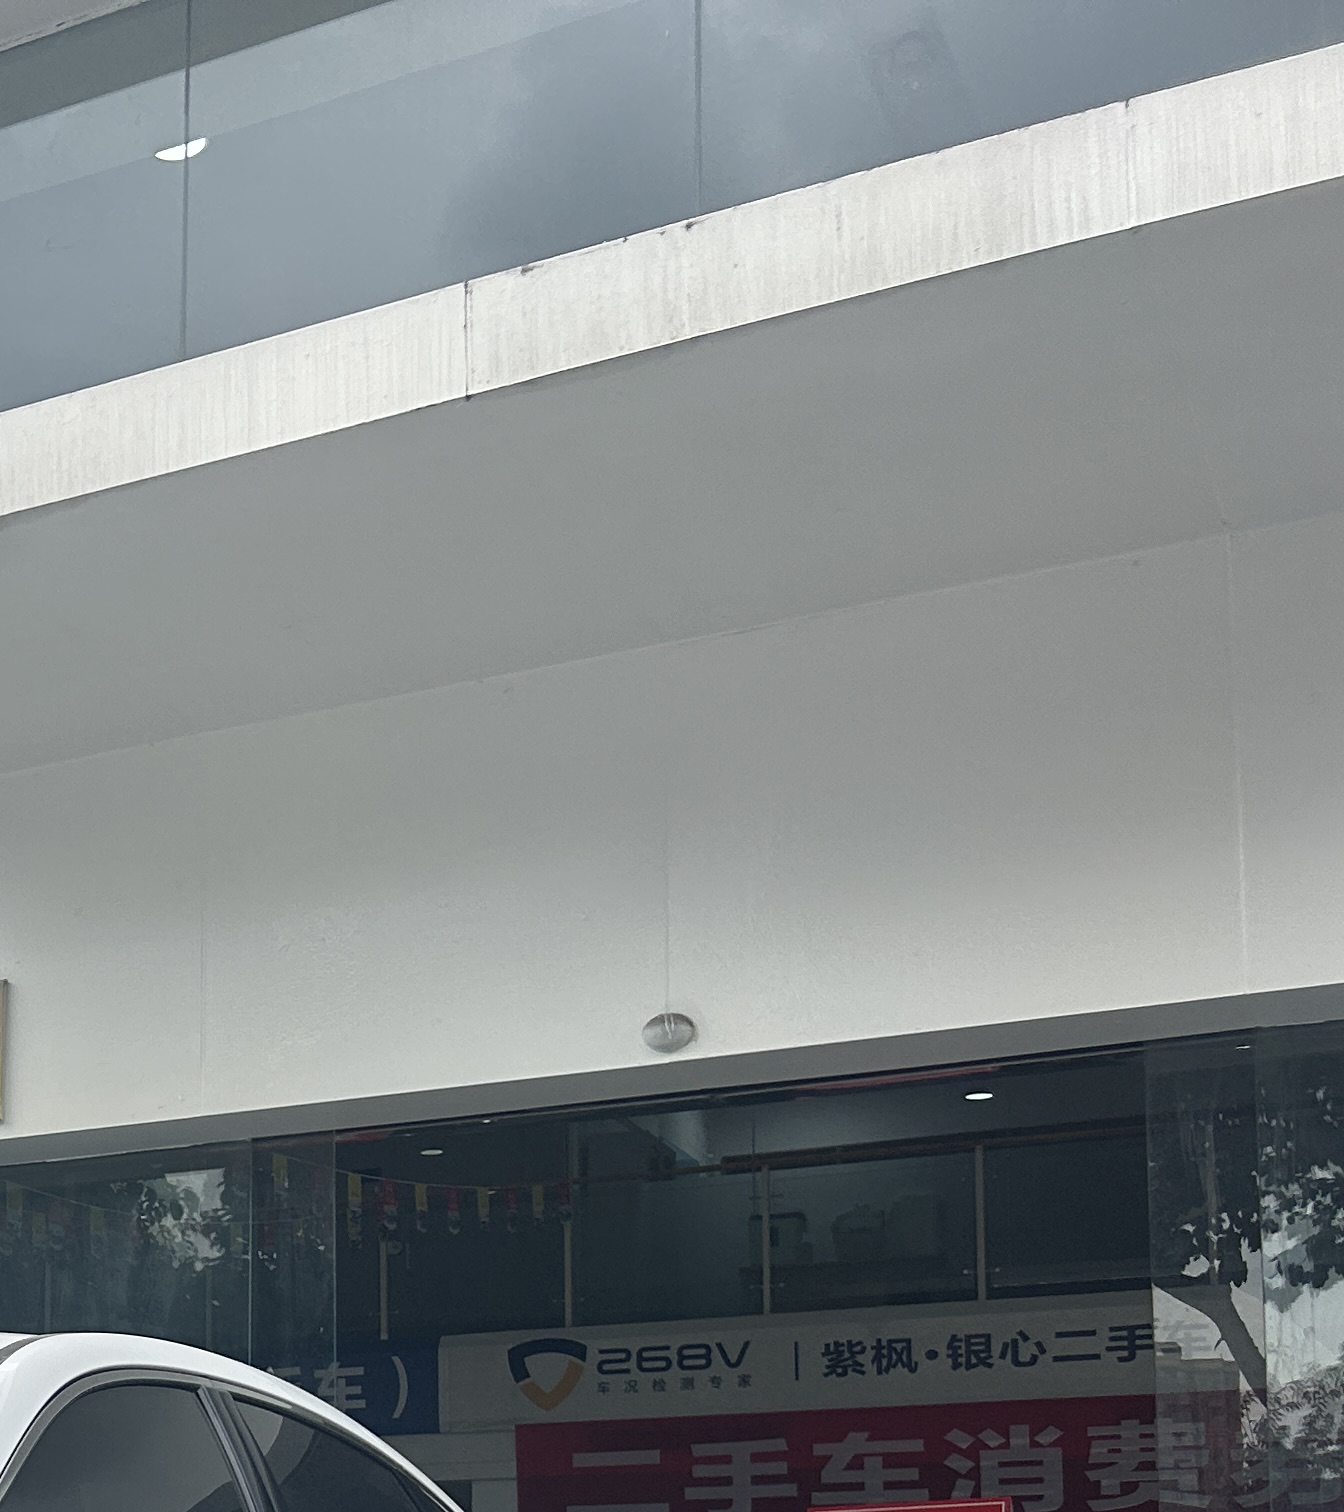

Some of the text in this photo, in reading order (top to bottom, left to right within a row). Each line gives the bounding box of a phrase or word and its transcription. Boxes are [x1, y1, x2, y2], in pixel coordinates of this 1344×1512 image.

[595, 1340, 752, 1376] 268V
[596, 1373, 753, 1395] 车况检测专家
